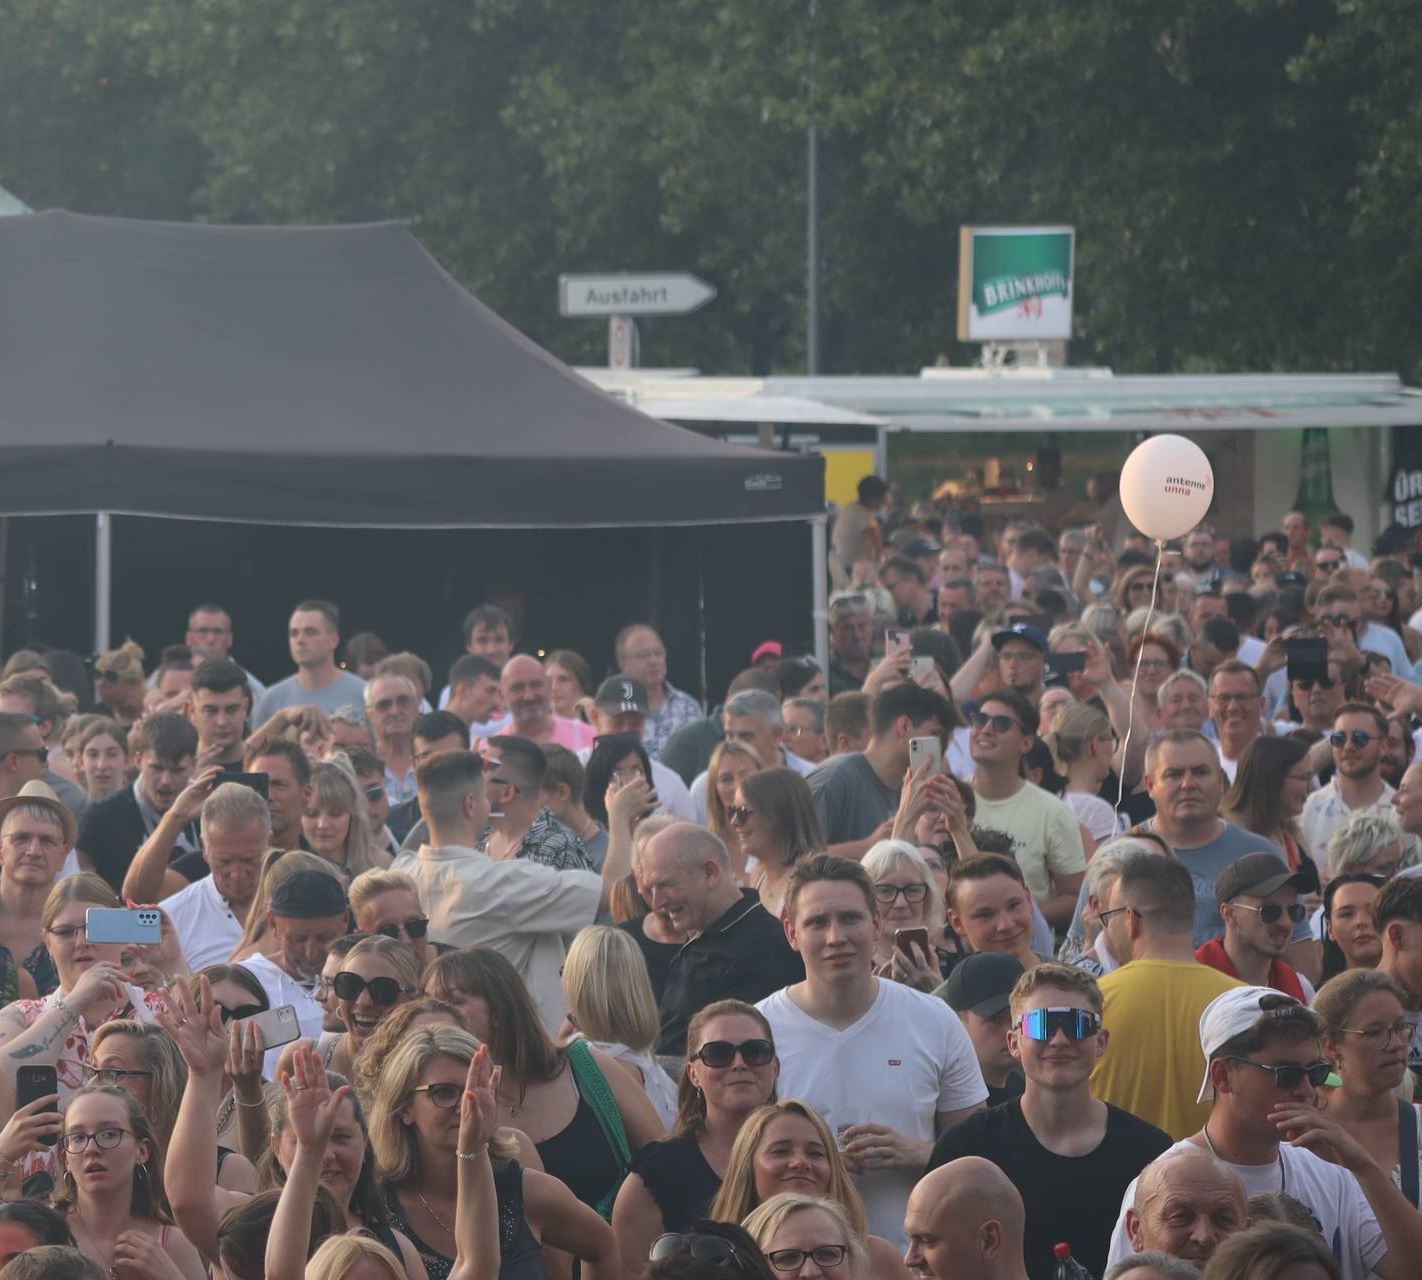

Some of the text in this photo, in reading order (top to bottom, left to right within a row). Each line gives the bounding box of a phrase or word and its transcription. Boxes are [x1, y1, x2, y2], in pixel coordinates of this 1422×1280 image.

[585, 286, 669, 305] Ausfahrt
[1164, 485, 1191, 497] unna
[1165, 476, 1207, 491] antenne
